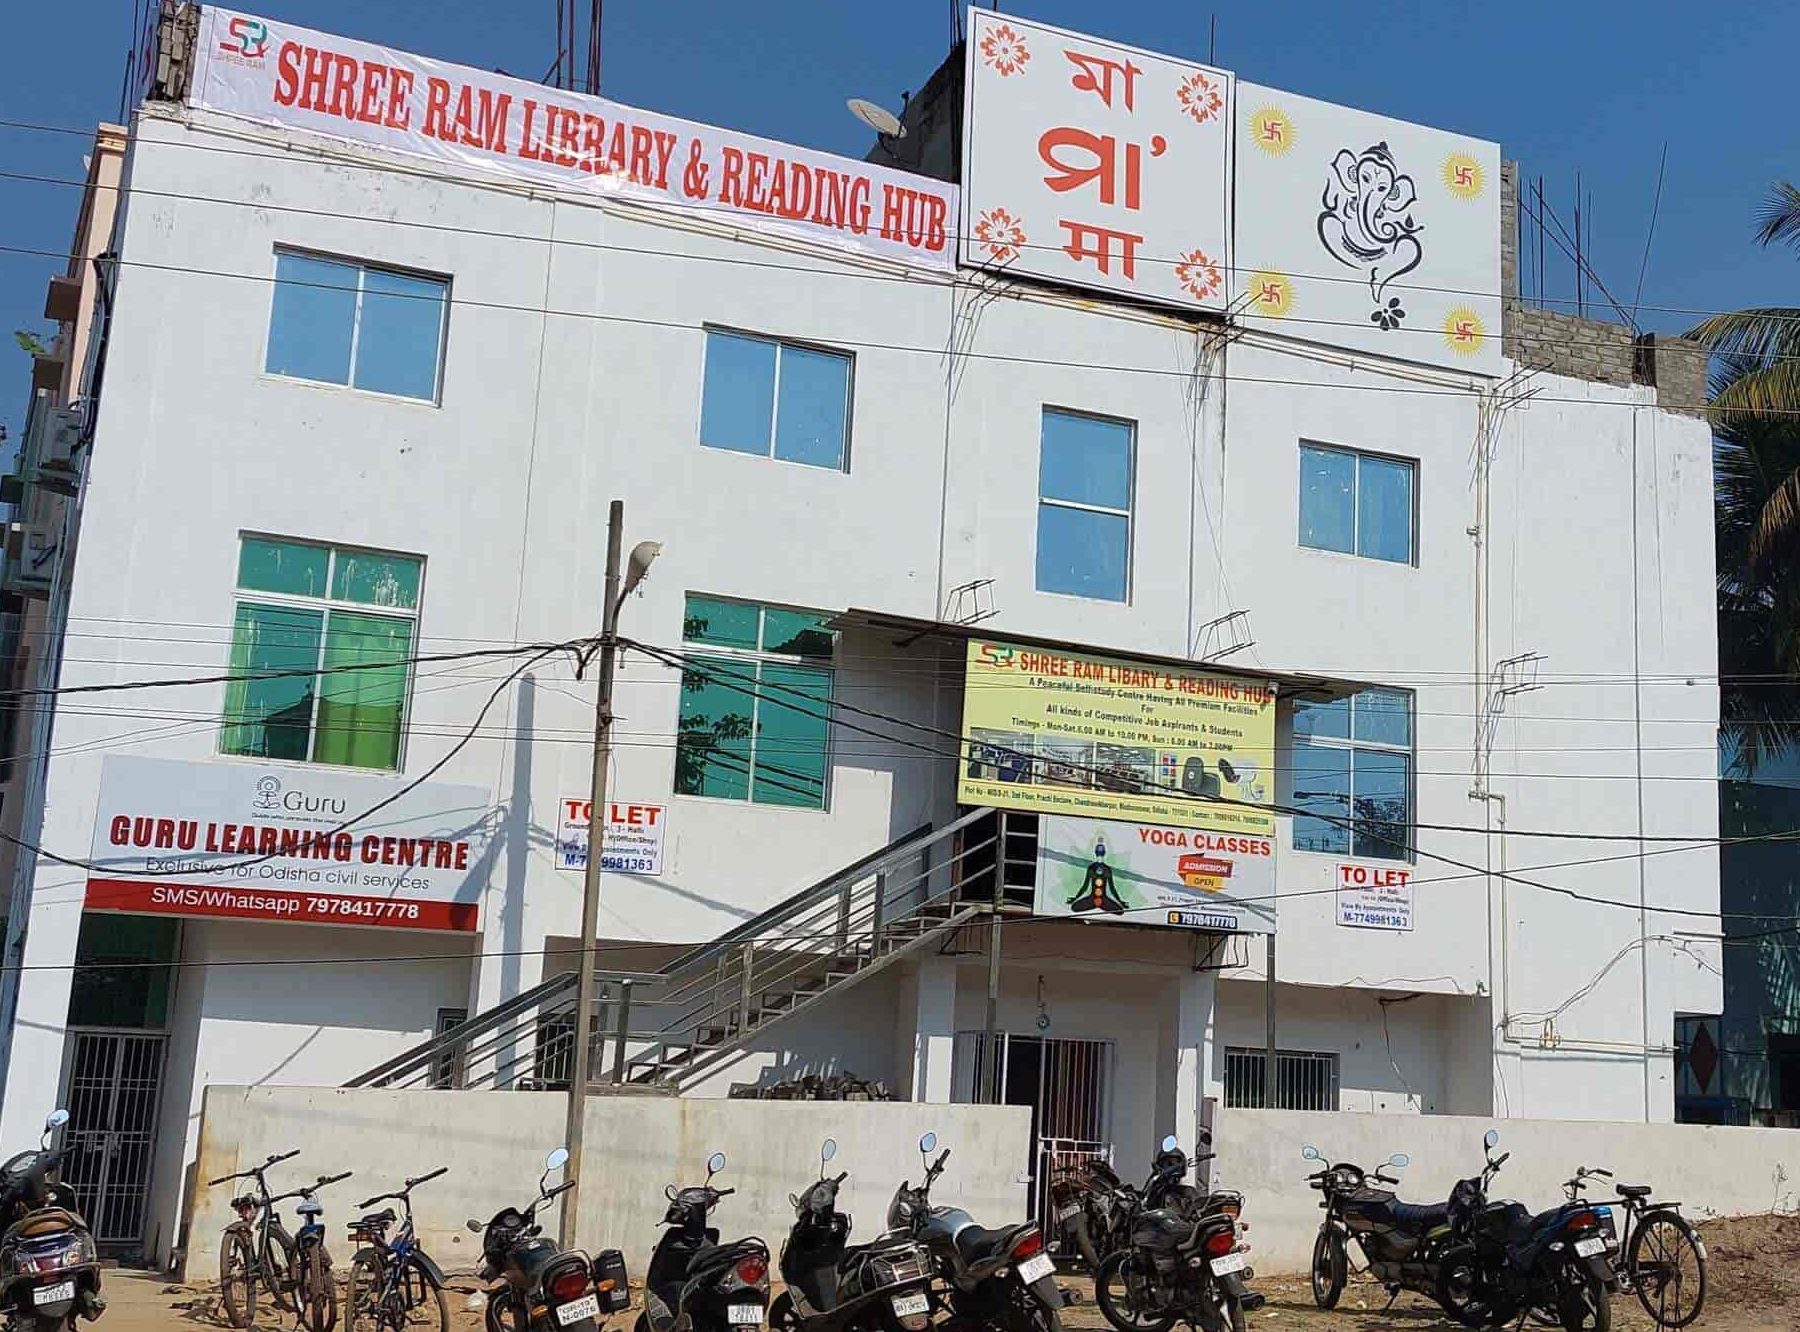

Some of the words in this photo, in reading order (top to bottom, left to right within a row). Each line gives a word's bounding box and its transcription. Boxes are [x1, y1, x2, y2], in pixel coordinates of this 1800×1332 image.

[1063, 49, 1142, 113] মা
[274, 40, 415, 132] SHREE
[422, 76, 513, 154] RAM
[518, 99, 677, 191] LIBRARY
[683, 138, 710, 200] &
[718, 146, 870, 236] READING
[880, 183, 947, 252] HUB
[1059, 219, 1144, 281] मा
[1020, 653, 1069, 677] SHREE
[1073, 660, 1104, 682] RAM
[1108, 664, 1160, 690] LIBARY
[1163, 672, 1174, 690] &
[1179, 676, 1239, 701] READING
[1244, 683, 1272, 704] HUB
[1046, 703, 1058, 714] All
[1060, 704, 1082, 717] kinds
[1084, 708, 1093, 719] of
[1094, 709, 1143, 726] Competitive
[1145, 716, 1160, 728] Job
[1161, 718, 1199, 733] Aspirants
[1209, 724, 1243, 738] Students
[1187, 697, 1222, 712] Premium
[1223, 703, 1258, 716] Facilities
[1012, 716, 1040, 730] Timings
[283, 790, 346, 814] Guru
[611, 804, 661, 826] LET
[109, 814, 198, 851] GURU
[204, 823, 353, 863] LEARNING
[360, 833, 470, 871] CENTRE
[1139, 828, 1189, 848] YOGA
[1194, 834, 1271, 857] CLASSES
[146, 856, 225, 876] Exclusive
[230, 862, 254, 879] for
[259, 863, 320, 883] Odisha
[326, 868, 358, 887] civil
[363, 873, 430, 891] services
[564, 853, 653, 871] M-79981363
[1183, 861, 1228, 873] ADMISSION
[1194, 877, 1214, 887] OPEN
[1340, 866, 1366, 884] TO
[1374, 870, 1410, 888] LET
[151, 886, 300, 915] SMS/Whatsapp
[306, 896, 419, 920] 7978417778
